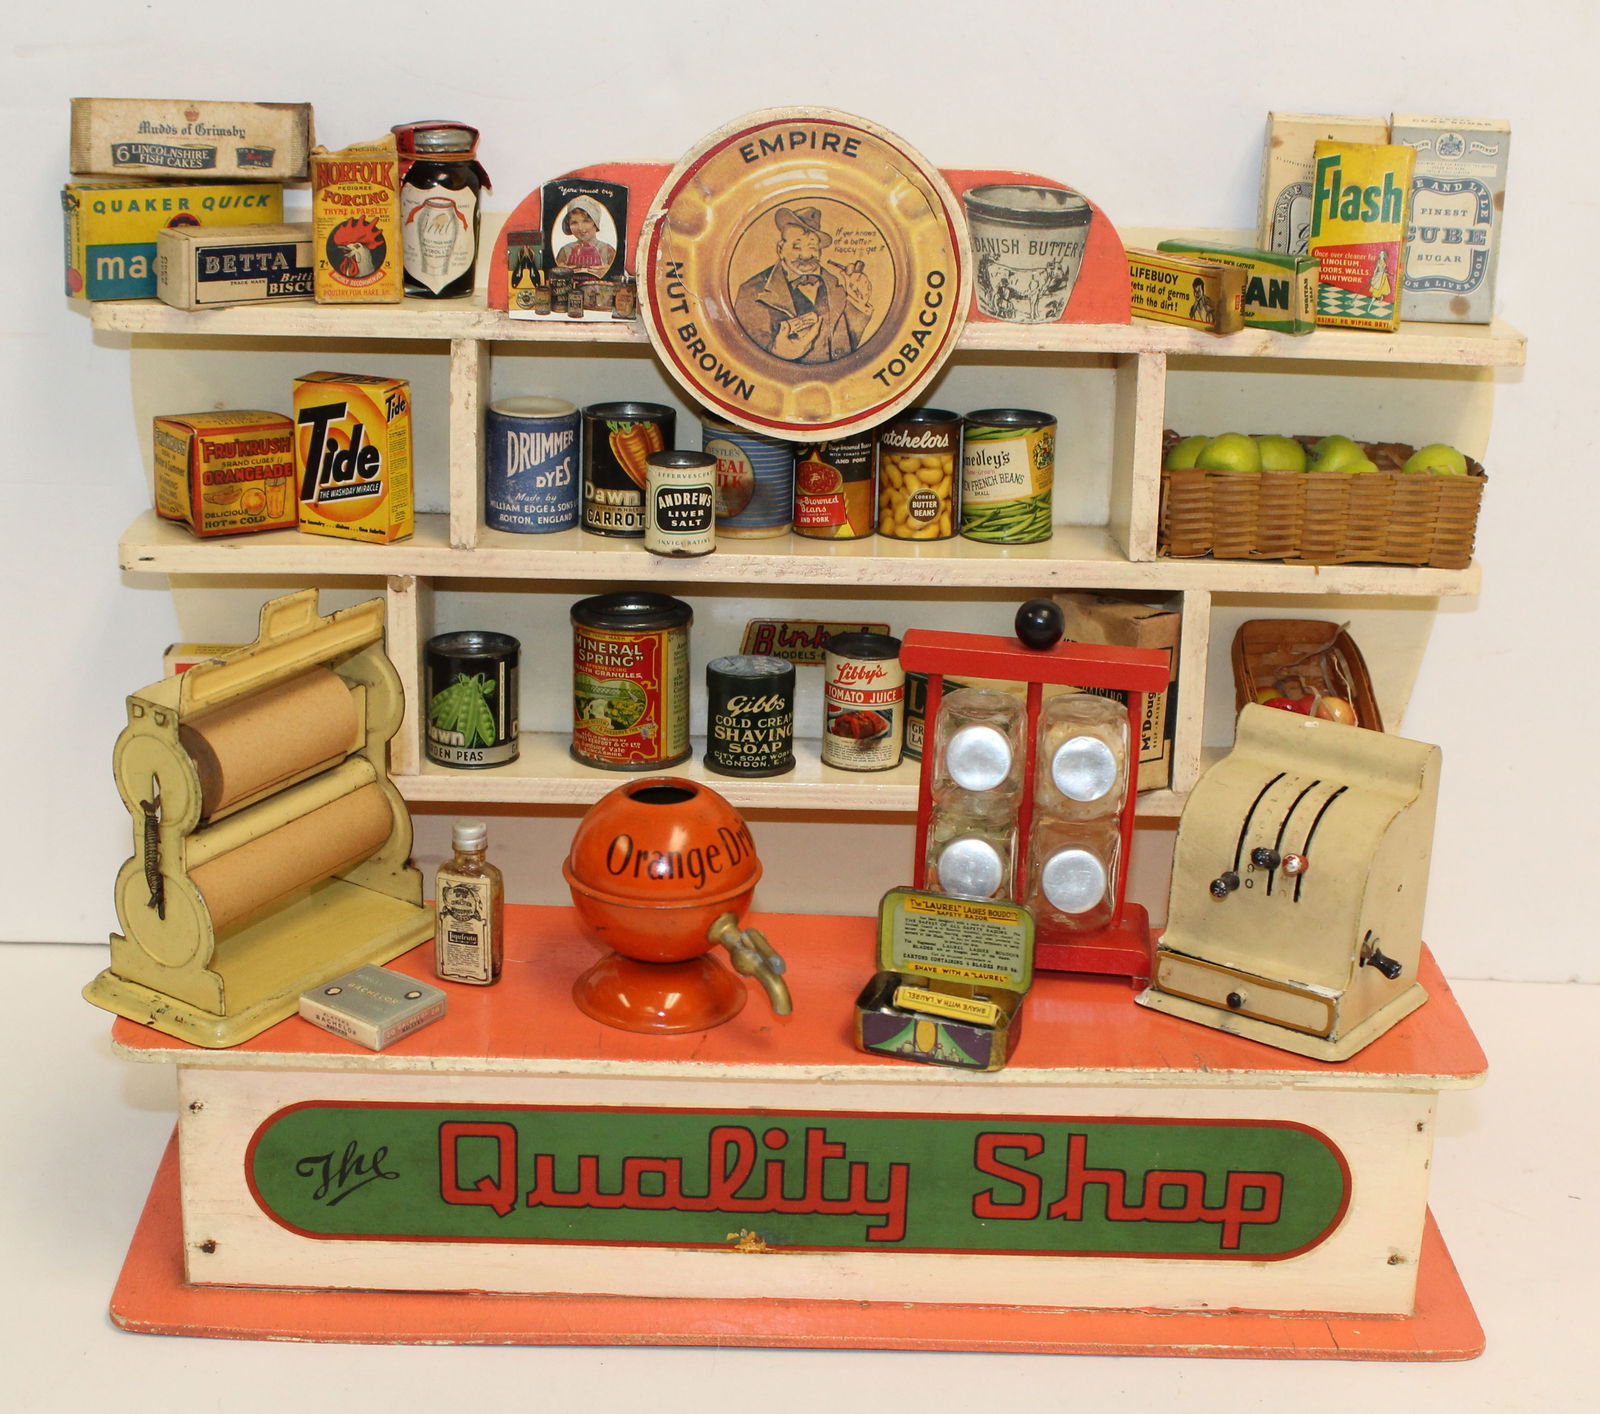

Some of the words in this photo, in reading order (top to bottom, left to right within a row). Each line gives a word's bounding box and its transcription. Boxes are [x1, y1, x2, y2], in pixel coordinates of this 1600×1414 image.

[181, 123, 192, 135] of
[195, 123, 246, 139] Grimsby
[116, 145, 130, 162] 6
[132, 145, 210, 160] LINCOLNSHIRE
[739, 131, 862, 164] EMPIRE
[140, 154, 164, 165] FISH
[167, 157, 203, 169] CAKES
[316, 161, 395, 192] NORFOLK
[558, 185, 577, 196] You
[602, 188, 615, 197] try
[1431, 182, 1462, 191] AND
[93, 198, 190, 215] QUAKER
[201, 194, 271, 210] QUICK
[322, 189, 390, 206] FORCING
[1311, 154, 1404, 238] Flash
[1420, 207, 1468, 217] FINEST
[975, 237, 1019, 255] DANISH
[1029, 240, 1079, 258] BUTTER
[205, 252, 289, 274] BETTA
[1417, 254, 1462, 263] SUGAR
[1130, 266, 1179, 285] LIFEBUOY
[1320, 275, 1362, 283] PAINTWORK
[666, 261, 690, 315] NUT
[1146, 282, 1156, 293] rid
[1158, 285, 1166, 295] of
[1167, 289, 1190, 302] germs
[1146, 297, 1158, 308] the
[1160, 300, 1178, 312] dirt!
[872, 270, 945, 387] TOBACCO
[676, 322, 755, 401] BROWN
[385, 394, 406, 423] Tide
[298, 402, 381, 501] Tide
[507, 430, 574, 478] DRUMMER
[963, 448, 1010, 469] medley's
[203, 463, 293, 486] ORANGEADE
[536, 456, 571, 488] DYES
[716, 459, 748, 475] EAL
[320, 489, 329, 499] THE
[330, 486, 355, 497] WASHDAY
[356, 482, 379, 494] MIRACLE
[971, 474, 998, 491] FRENCH
[999, 473, 1025, 485] BEANS
[514, 493, 540, 502] Made
[545, 493, 557, 503] by
[585, 480, 641, 506] Dawn
[658, 492, 712, 510] ANDREWS
[524, 504, 549, 513] EDGE
[550, 505, 555, 513] &
[912, 501, 938, 509] BUTTER
[914, 509, 935, 517] BEANS
[204, 509, 249, 519] DELICIOUS
[205, 520, 226, 528] HOT
[240, 515, 266, 525] COLD
[537, 513, 572, 525] ENGLAND
[668, 510, 704, 518] LIVER
[671, 519, 702, 527] SALT
[576, 634, 643, 655] MINERAL
[773, 651, 816, 660] MODELS
[595, 670, 643, 679] GRANULES
[833, 663, 887, 686] Libby's
[828, 687, 864, 703] TOMATO
[869, 690, 897, 704] JUICE
[727, 694, 785, 718] Gibbs
[715, 714, 751, 728] COLD
[714, 723, 793, 742] SHAVING
[457, 750, 484, 761] PEAS
[714, 751, 734, 760] CITY
[728, 742, 782, 754] SOAP
[606, 833, 723, 890] Orange
[936, 910, 961, 918] SAFETY
[963, 907, 987, 916] LADIES
[914, 964, 937, 973] SHAVE
[944, 1000, 961, 1009] WITH
[315, 1014, 357, 1036] BACHELOR
[295, 1140, 400, 1206] The
[439, 1121, 910, 1242] Quality
[972, 1131, 1284, 1250] Shop
